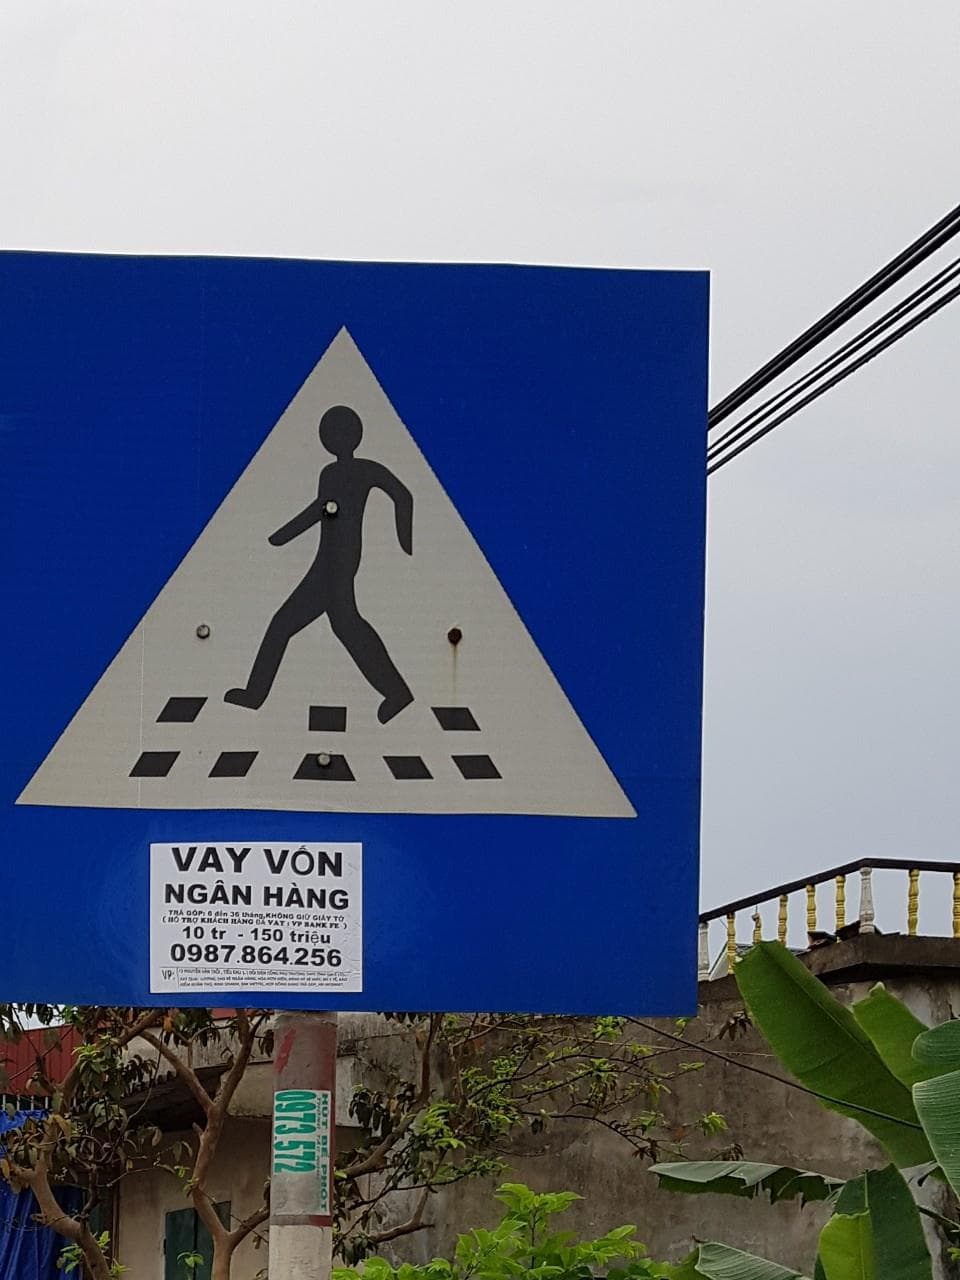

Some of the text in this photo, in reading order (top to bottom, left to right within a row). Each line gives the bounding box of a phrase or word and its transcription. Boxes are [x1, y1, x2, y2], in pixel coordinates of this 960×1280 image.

[171, 845, 343, 877] VAY VỐN
[164, 879, 349, 910] NGÂN HÀNG
[182, 926, 205, 940] 10
[211, 927, 227, 940] tr
[250, 928, 284, 942] 150
[290, 930, 331, 946] triệu
[170, 943, 342, 968] 0987.864.256
[274, 1090, 317, 1174] 0973.572
